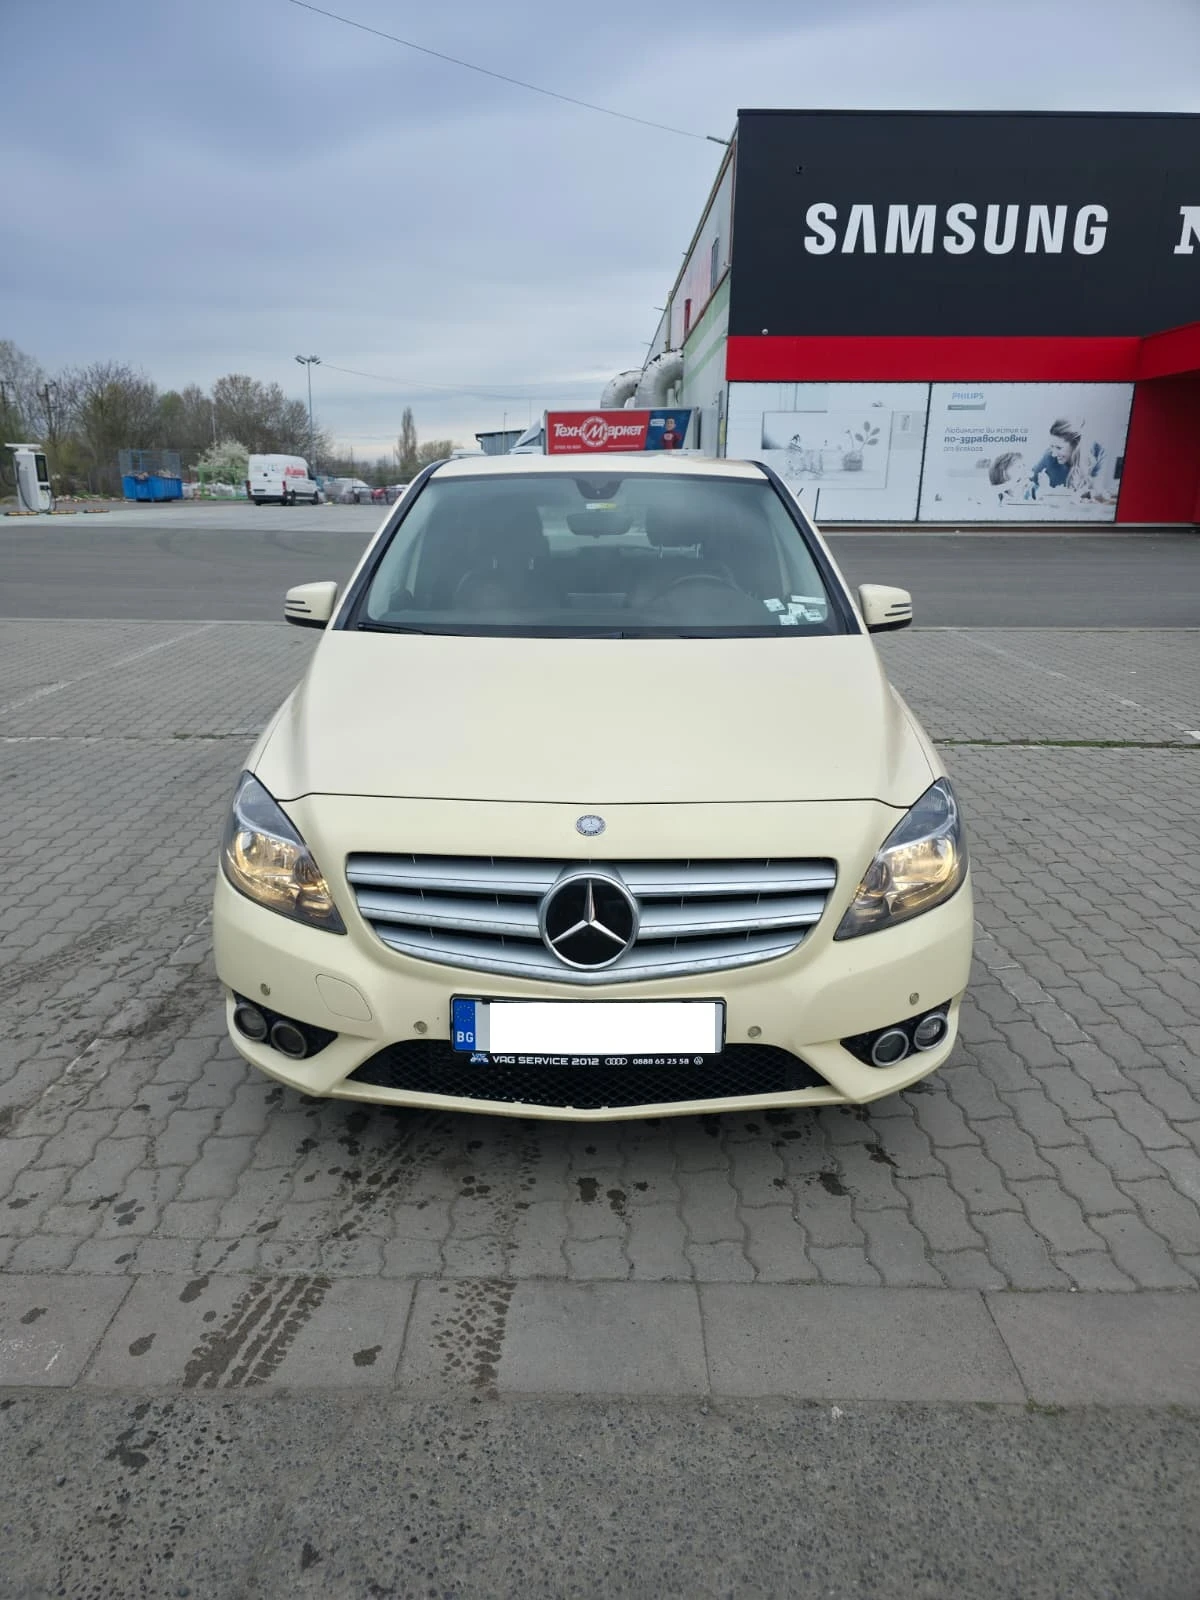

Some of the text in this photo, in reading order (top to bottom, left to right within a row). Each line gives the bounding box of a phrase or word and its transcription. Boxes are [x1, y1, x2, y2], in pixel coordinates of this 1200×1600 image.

[804, 202, 1109, 255] SAMSUNG
[952, 392, 984, 400] PHILIPS
[944, 434, 1028, 444] по-здравословни
[456, 1031, 474, 1043] BG
[492, 1055, 516, 1064] VAG
[518, 1056, 569, 1065] SERVICE
[571, 1057, 600, 1066] 2012
